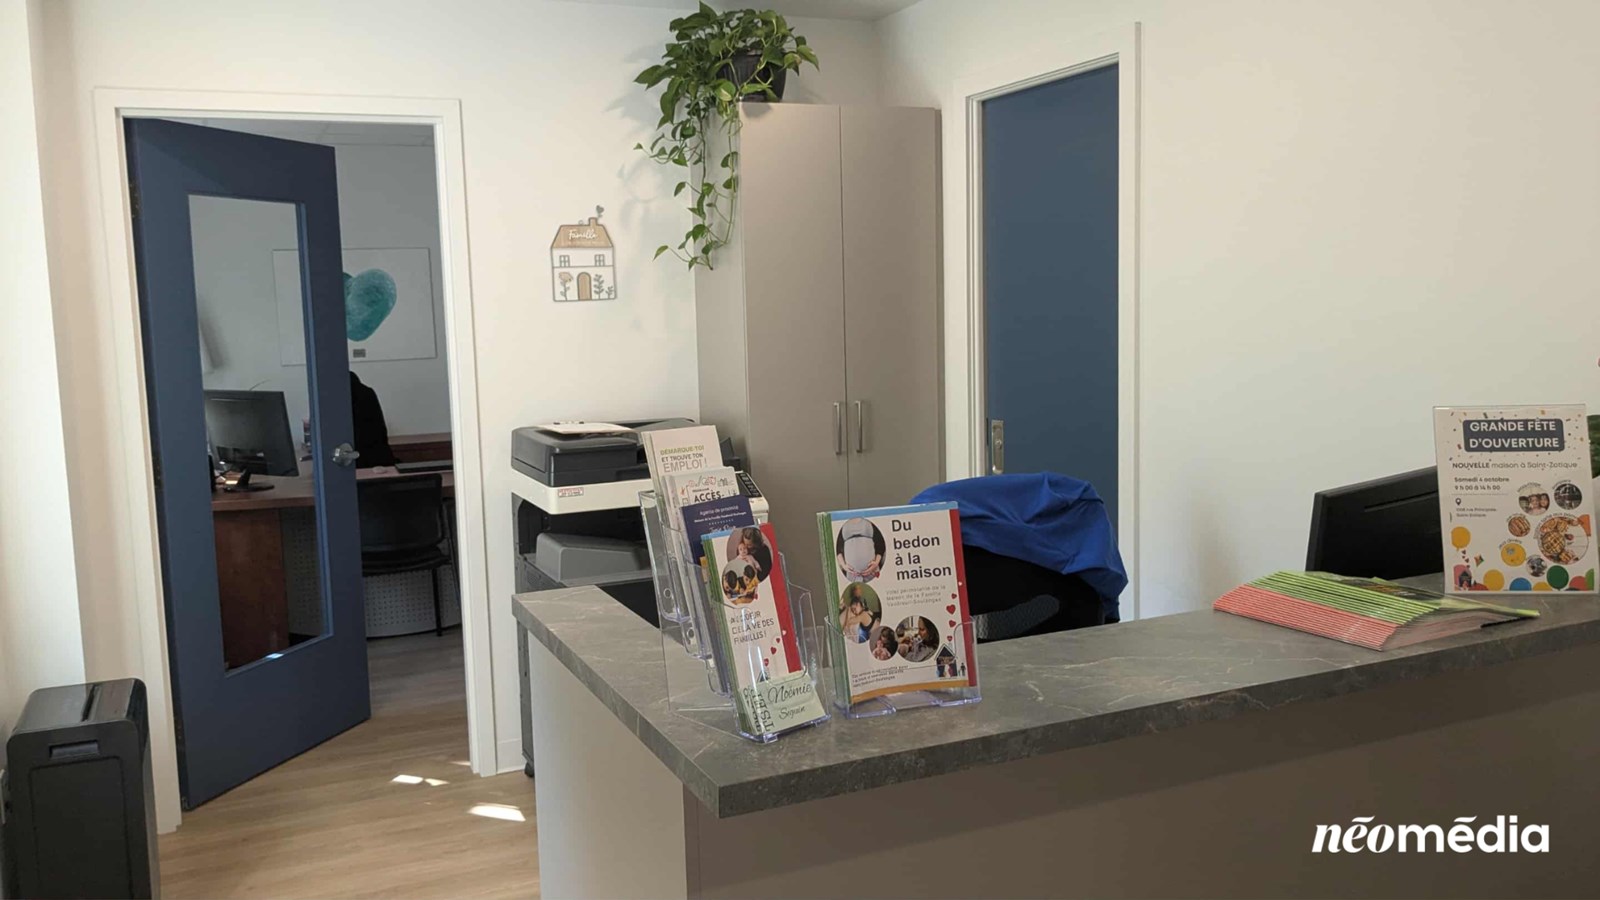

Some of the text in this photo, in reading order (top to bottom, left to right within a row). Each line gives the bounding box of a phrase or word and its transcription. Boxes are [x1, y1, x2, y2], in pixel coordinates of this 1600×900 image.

[1469, 417, 1557, 432] GRANDE FÊTE
[1469, 437, 1560, 449] D'OUVERTURE
[670, 453, 692, 462] TROUVE
[663, 458, 703, 473] EMPLOI
[1520, 461, 1526, 469] à
[1527, 461, 1578, 470] Saint-Zotique
[891, 519, 912, 532] Du
[893, 535, 940, 550] bedon
[894, 552, 921, 566] à la
[896, 565, 952, 581] maison
[761, 617, 775, 628] DES
[767, 683, 811, 703] Noémie
